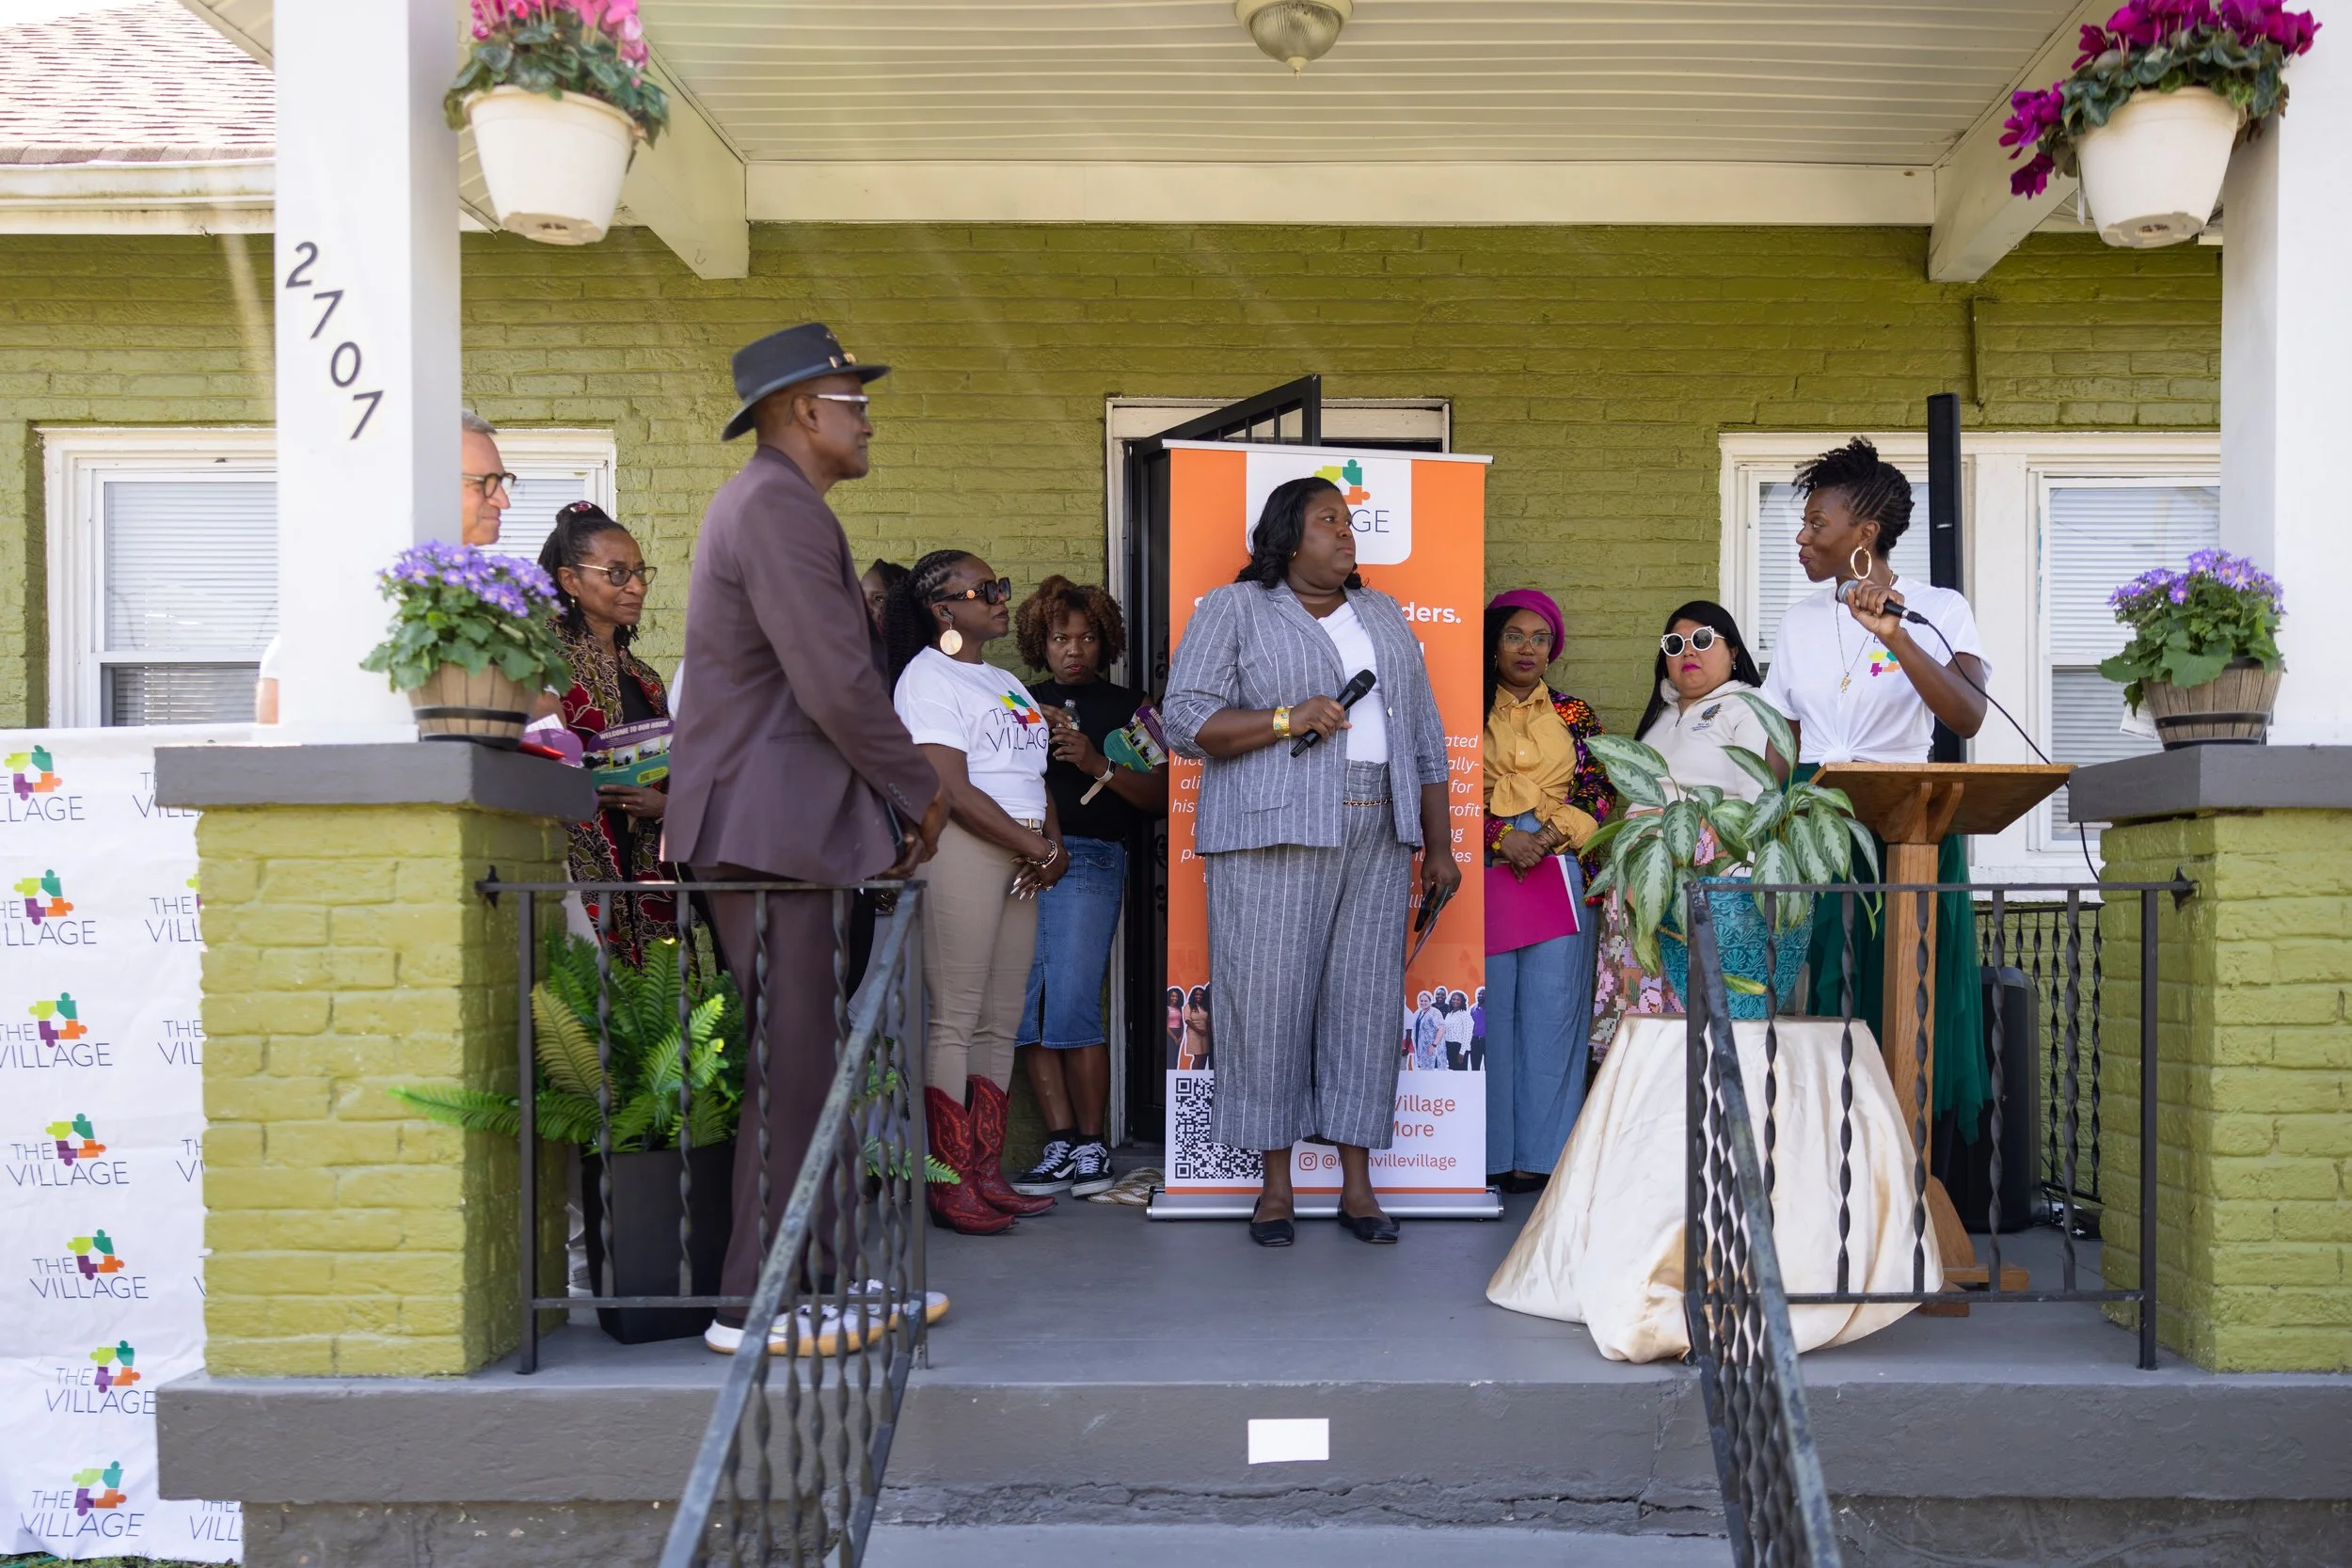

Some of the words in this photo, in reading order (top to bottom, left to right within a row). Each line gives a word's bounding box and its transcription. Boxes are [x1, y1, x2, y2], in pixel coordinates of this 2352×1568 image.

[285, 241, 385, 441] 2707
[1351, 509, 1390, 533] GE
[1401, 602, 1462, 624] ders.
[1445, 735, 1479, 749] ated
[1448, 756, 1480, 774] ally-
[1181, 775, 1201, 790] ali
[1451, 779, 1474, 794] for
[1172, 799, 1198, 814] his
[1449, 802, 1482, 817] rofit
[149, 896, 194, 915] THE
[4, 921, 98, 946] LLAGE
[145, 918, 204, 943] VILL
[162, 1020, 203, 1038] THE
[10, 1142, 54, 1161] THE
[6, 1162, 130, 1187] VILLAGE
[32, 1257, 76, 1275] THE
[29, 1276, 150, 1299] VILLAGE
[56, 1368, 94, 1386] THE
[45, 1388, 157, 1415] VILLAGE
[31, 1490, 73, 1509] THE
[20, 1512, 145, 1538] VILLAGE
[190, 1515, 239, 1542] VILL
